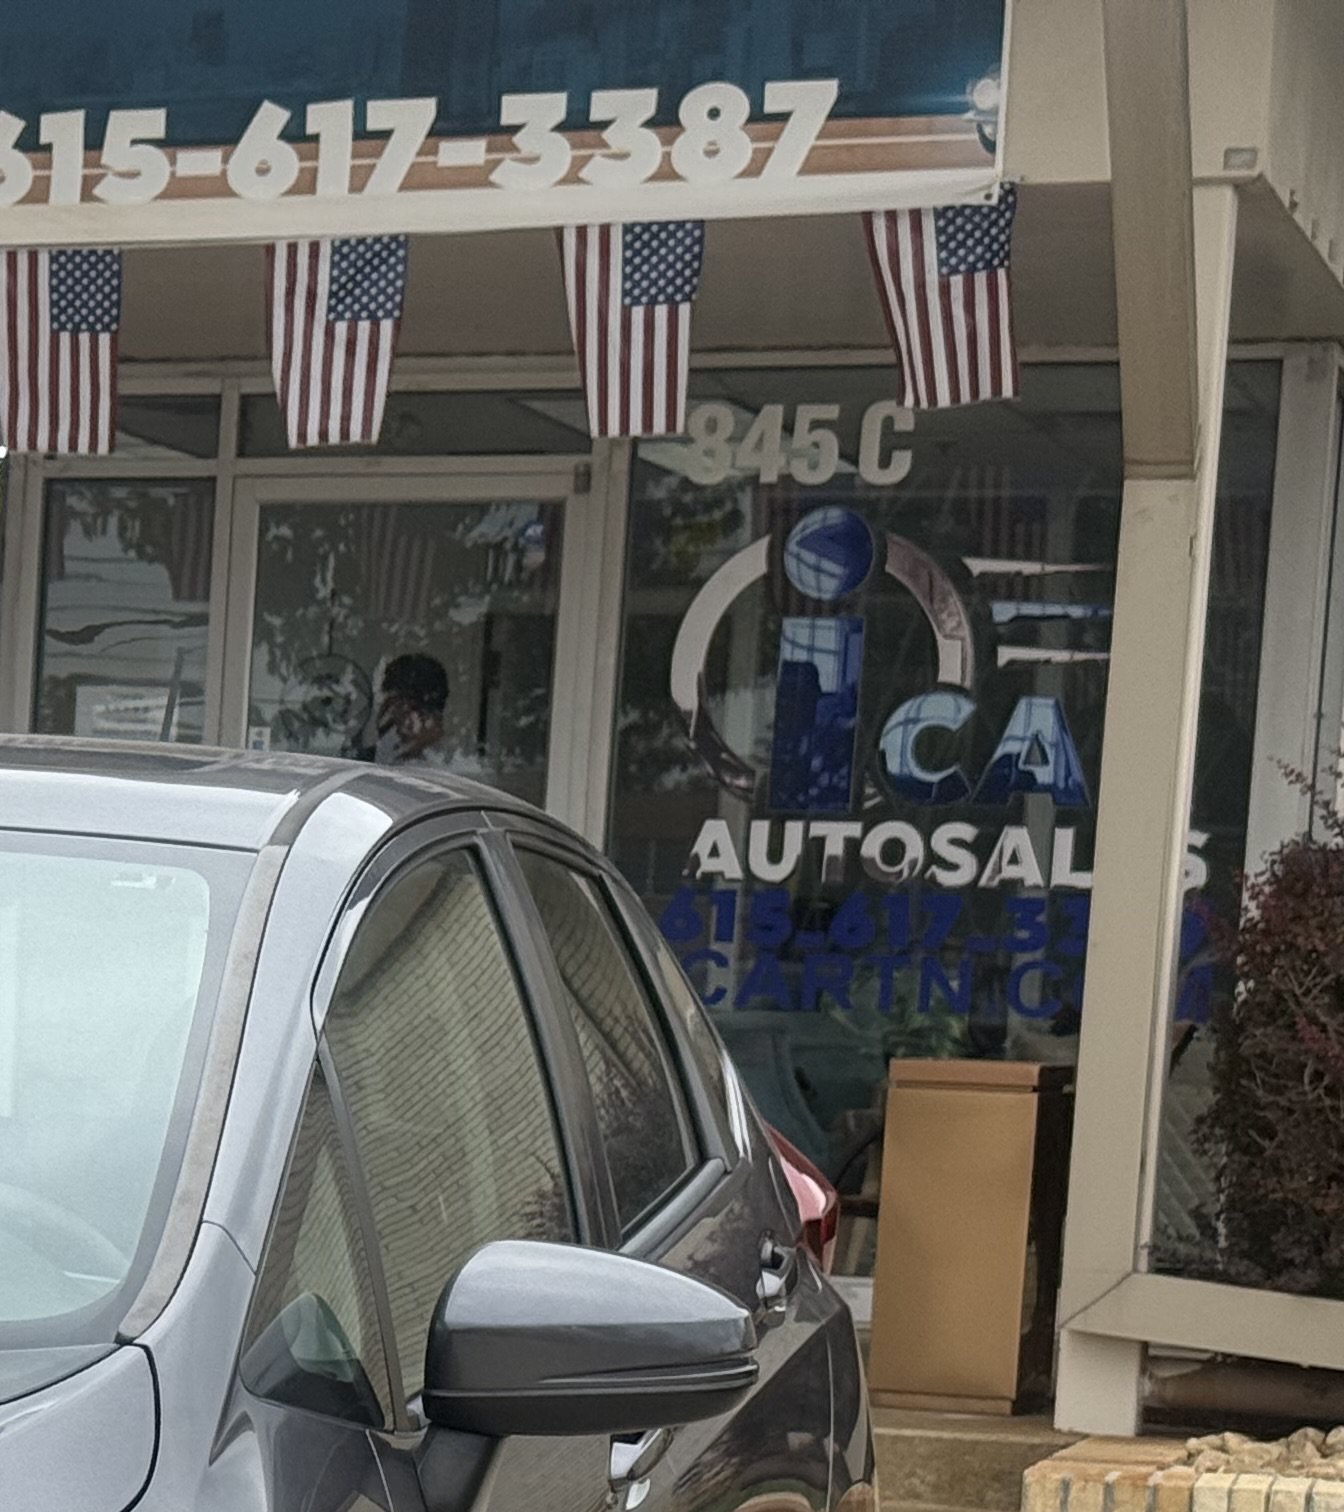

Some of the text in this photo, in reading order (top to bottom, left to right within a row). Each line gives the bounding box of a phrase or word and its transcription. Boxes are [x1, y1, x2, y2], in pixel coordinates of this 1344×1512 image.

[686, 402, 916, 486] 845 C
[682, 818, 1210, 892] AUTOSALS
